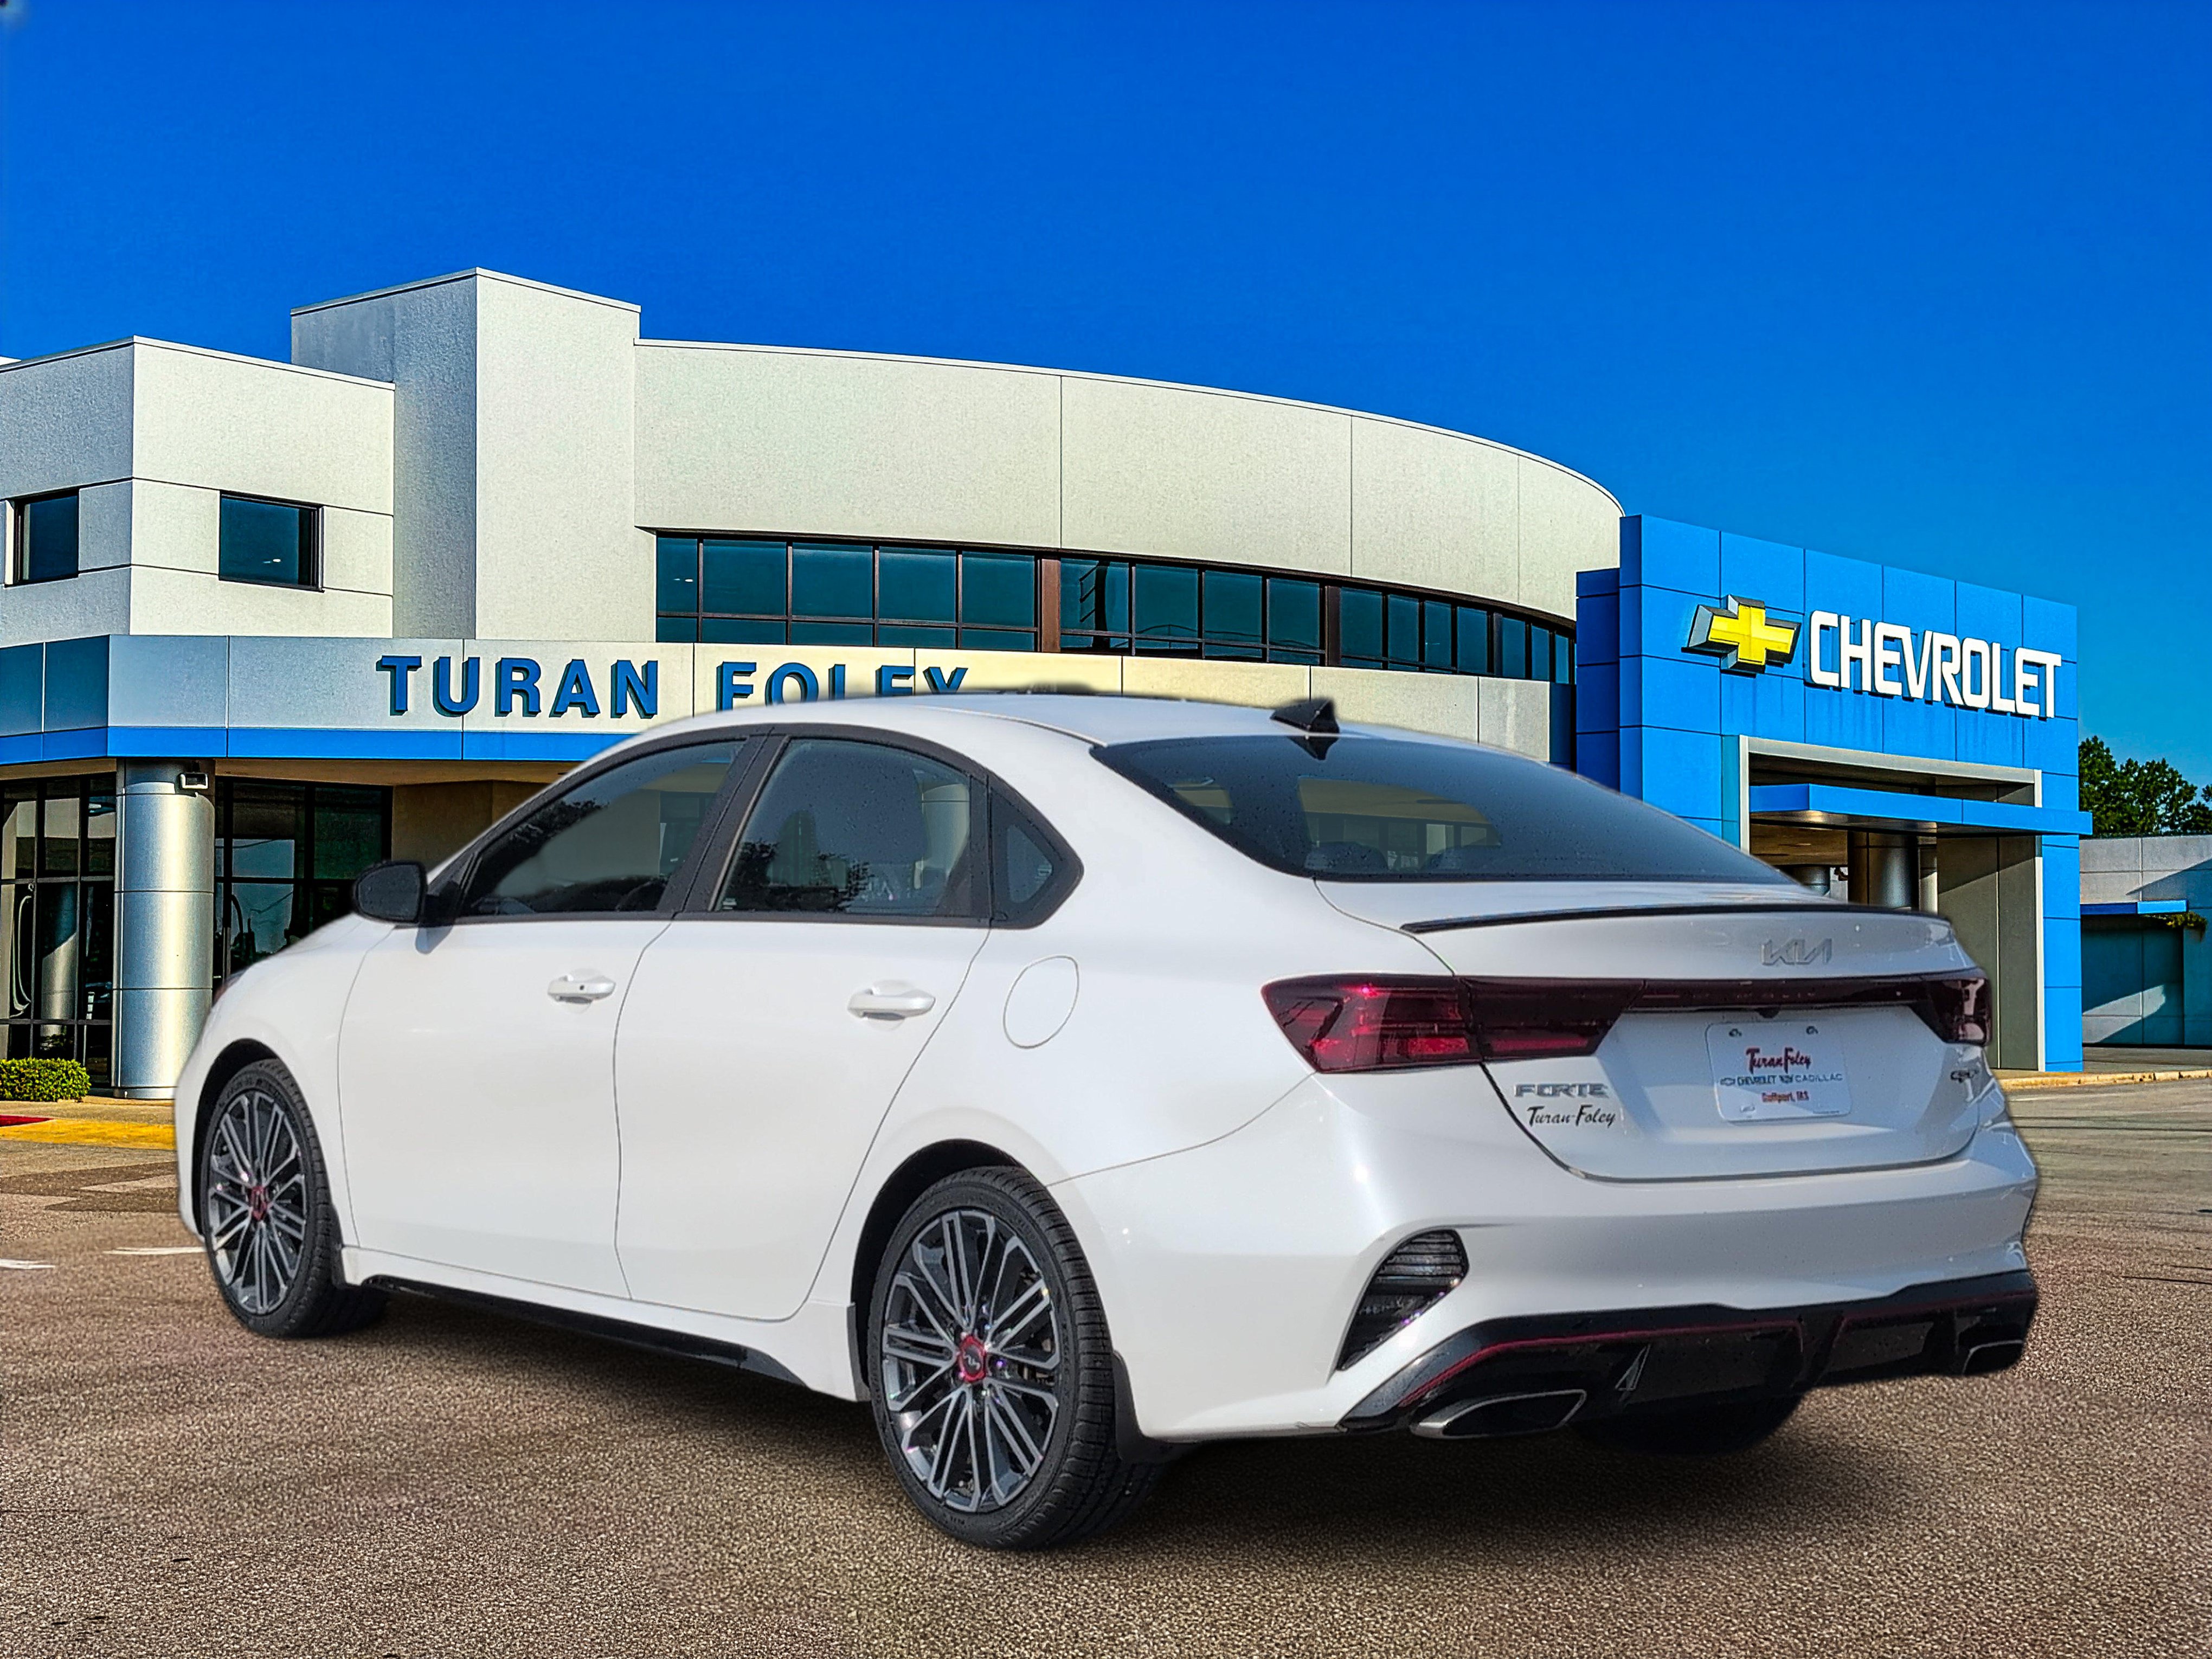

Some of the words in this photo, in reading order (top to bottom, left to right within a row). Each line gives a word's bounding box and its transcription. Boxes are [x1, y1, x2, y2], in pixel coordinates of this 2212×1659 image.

[1809, 610, 2062, 719] CHEVROLET
[376, 655, 658, 718] TURAN
[1514, 1083, 1609, 1098] FORTE
[1795, 1073, 1843, 1083] CADILLAC
